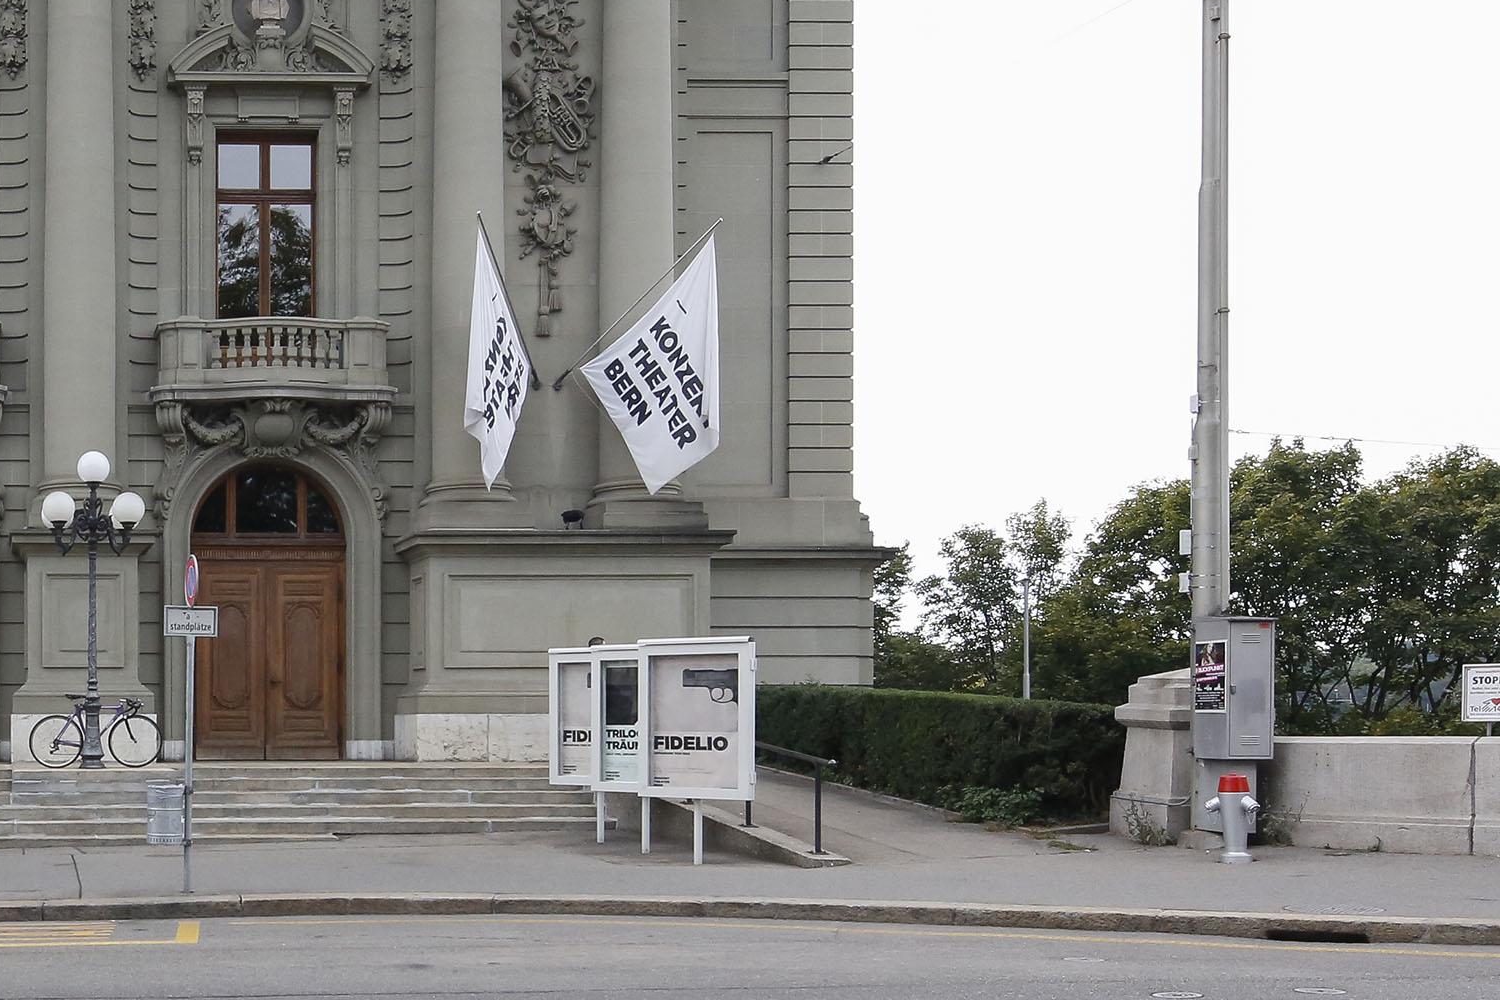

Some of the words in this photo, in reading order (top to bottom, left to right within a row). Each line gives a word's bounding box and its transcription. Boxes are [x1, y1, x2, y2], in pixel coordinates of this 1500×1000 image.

[603, 357, 653, 427] BERN
[628, 337, 698, 450] THEATER
[649, 315, 709, 429] KONZE
[563, 730, 591, 743] FID
[654, 736, 729, 751] FIDELIO
